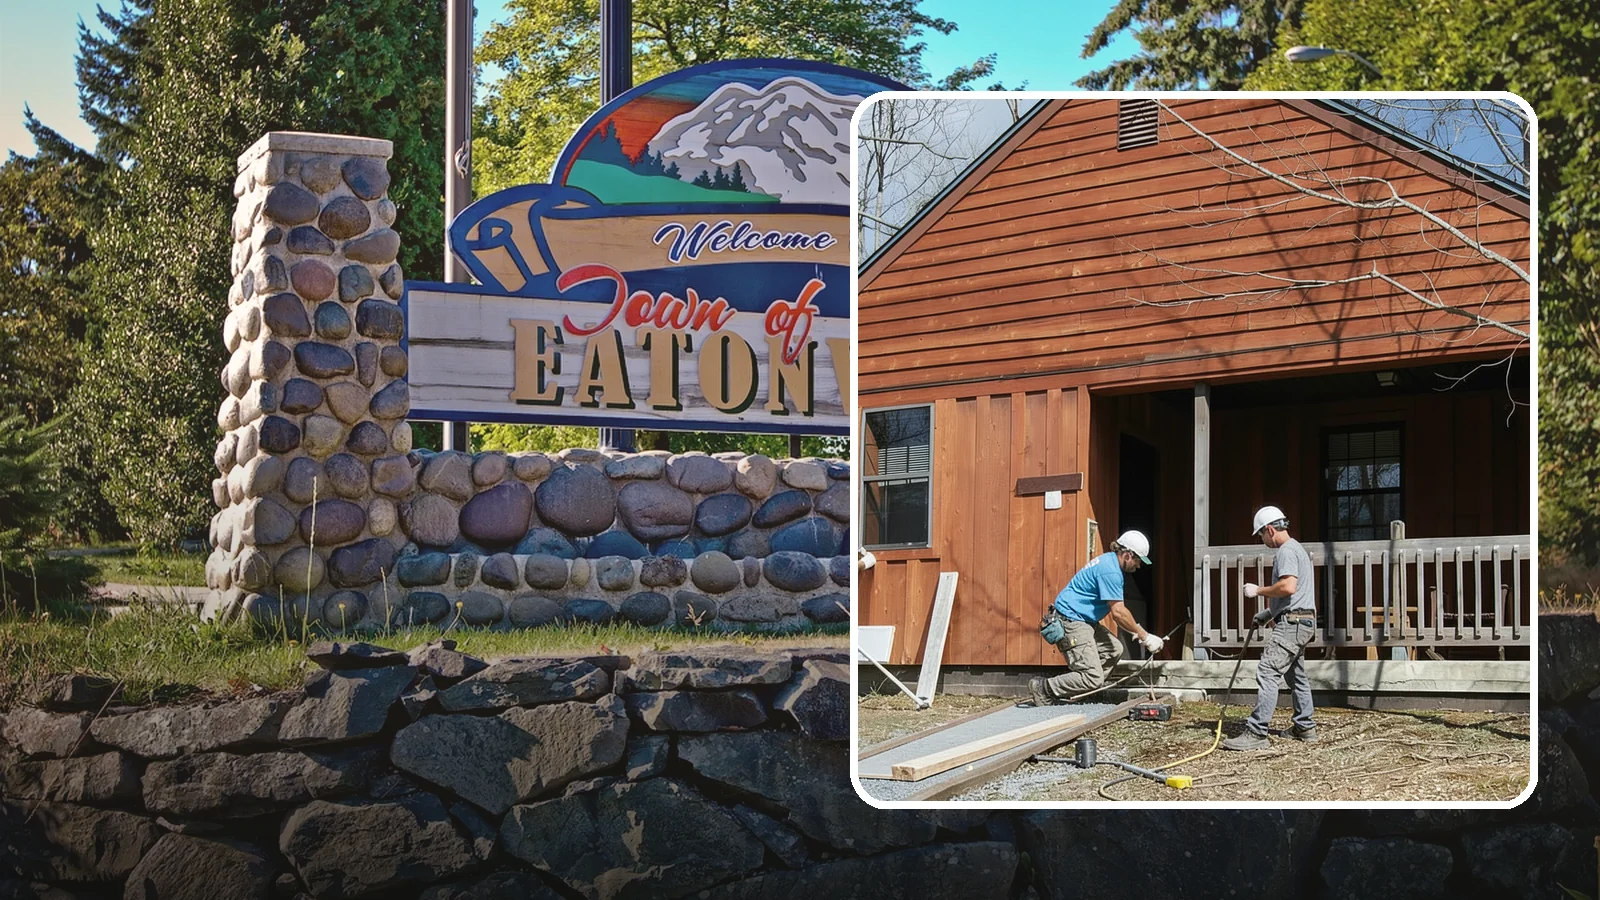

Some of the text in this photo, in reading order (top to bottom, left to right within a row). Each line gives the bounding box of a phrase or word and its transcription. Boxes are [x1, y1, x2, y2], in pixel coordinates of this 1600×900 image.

[654, 221, 836, 262] Welcome
[557, 263, 826, 366] Town of
